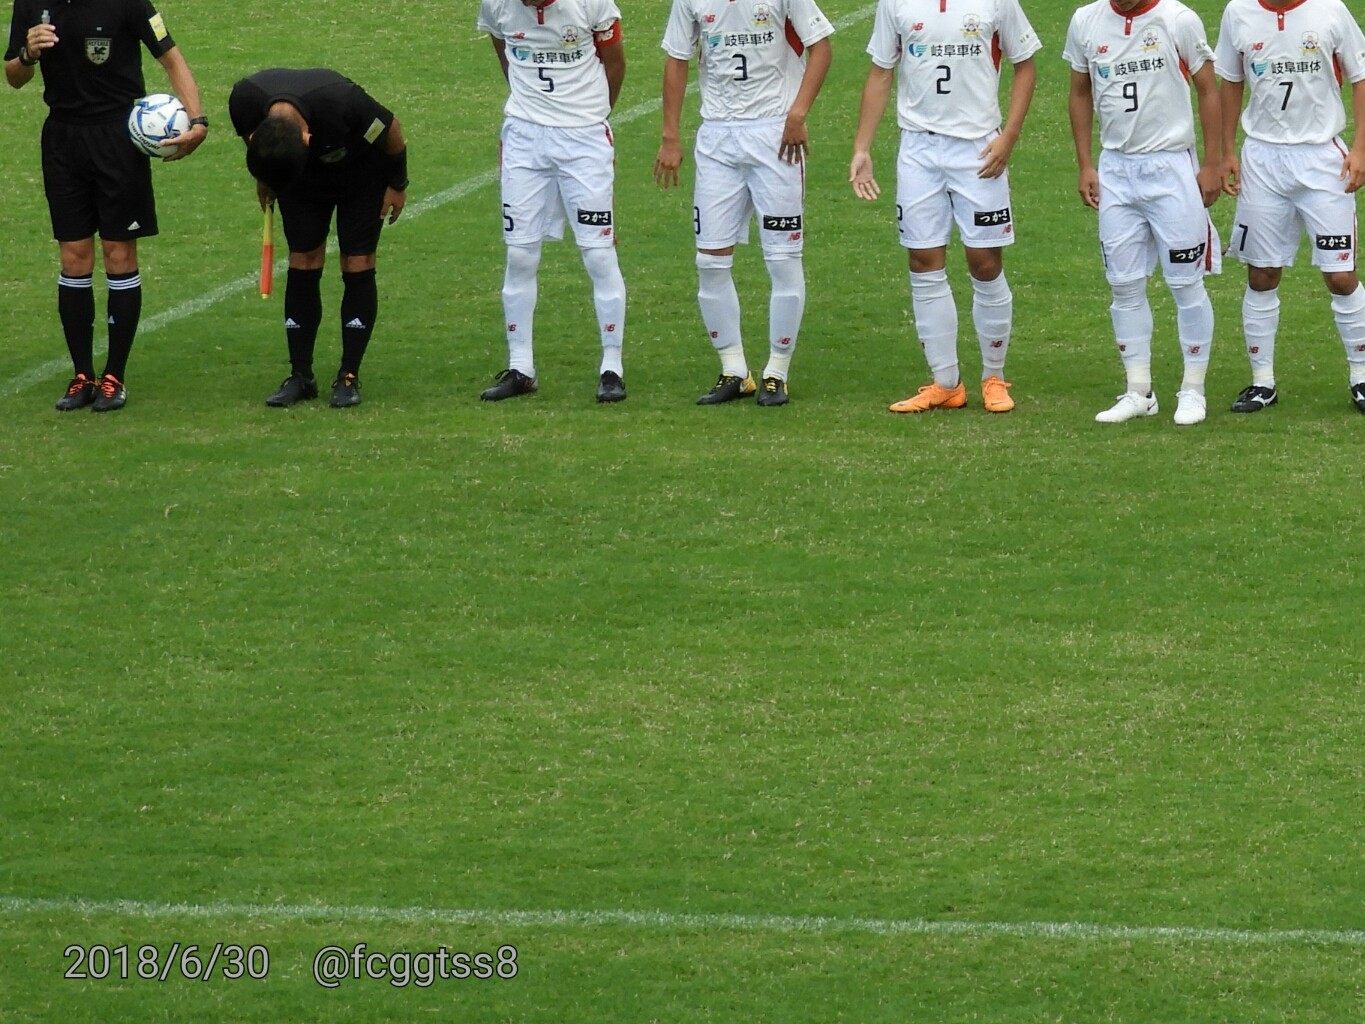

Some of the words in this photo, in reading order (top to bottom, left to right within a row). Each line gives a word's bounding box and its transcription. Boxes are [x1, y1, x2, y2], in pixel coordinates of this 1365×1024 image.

[725, 31, 775, 47] 岐阜車体
[532, 49, 583, 64] 岐阜車体
[930, 44, 982, 57] 岐阜車体
[732, 53, 747, 81] 3
[1114, 58, 1165, 76] 岐阜車体
[1271, 61, 1321, 75] 岐阜車体
[538, 67, 554, 93] 5
[936, 65, 951, 94] 2
[1122, 82, 1138, 112] 9
[1279, 82, 1293, 111] 7
[580, 213, 609, 223] つかさ
[767, 217, 797, 228] つかさ
[1238, 224, 1249, 251] 7
[1318, 237, 1347, 247] つかさ
